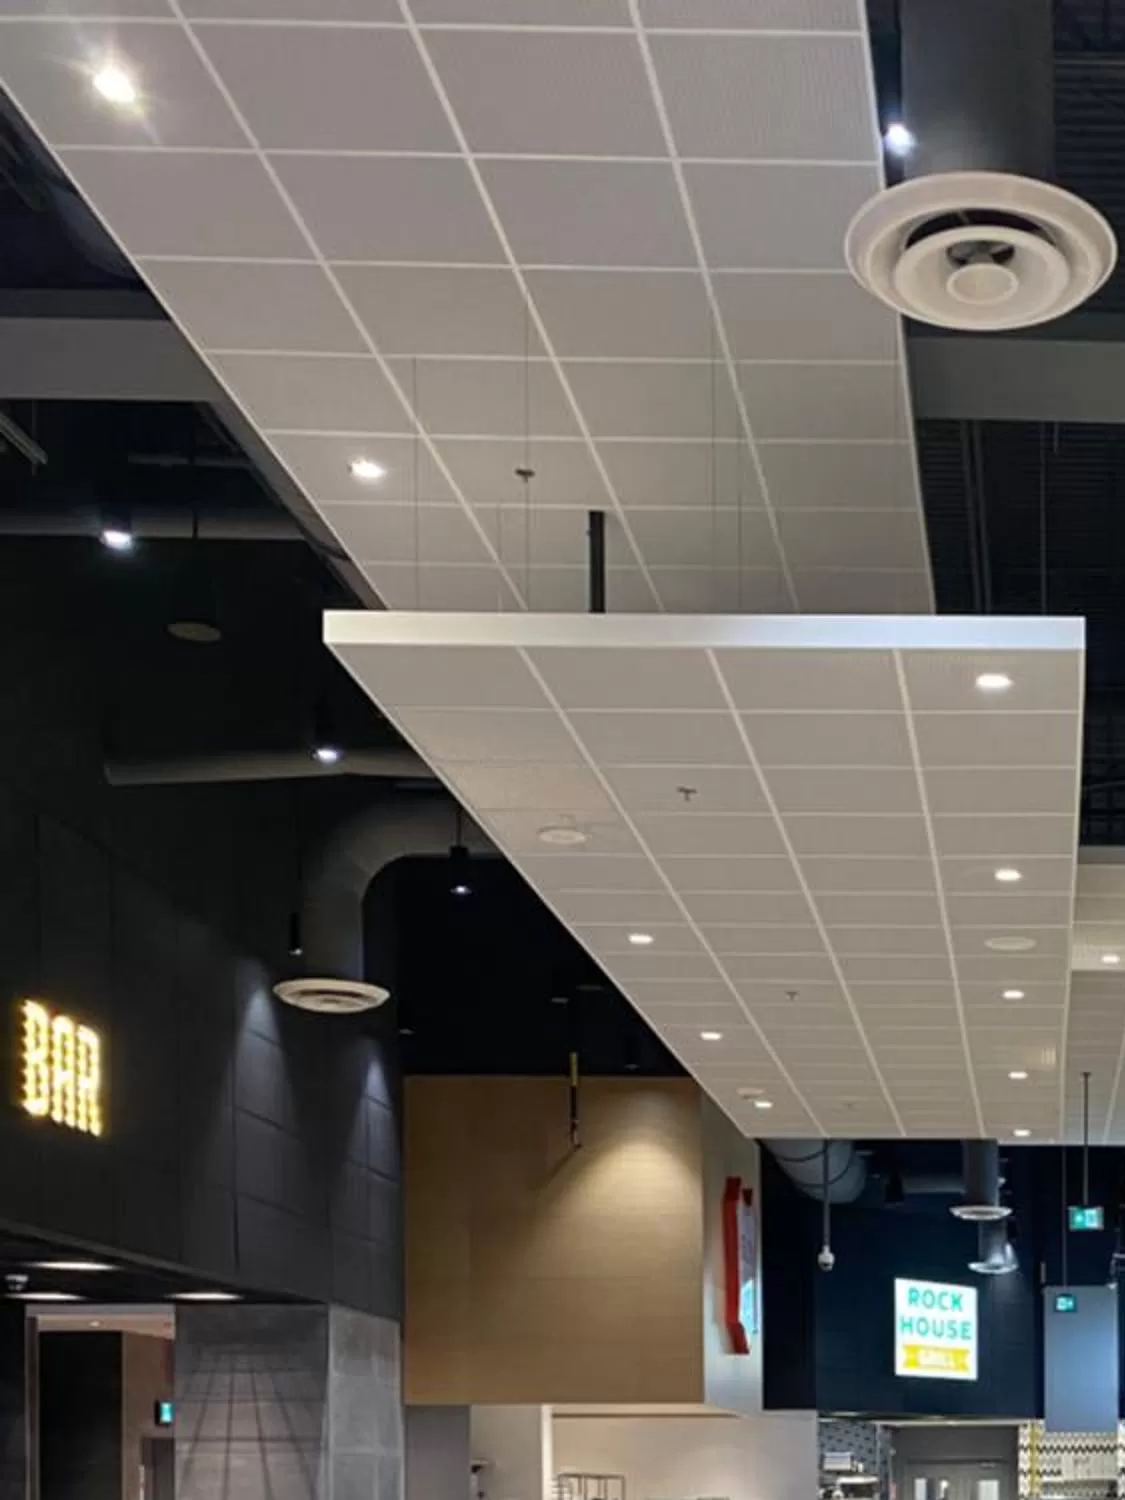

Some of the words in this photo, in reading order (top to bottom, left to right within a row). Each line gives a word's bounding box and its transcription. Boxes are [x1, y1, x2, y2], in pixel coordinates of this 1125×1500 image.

[21, 1000, 103, 1137] BAR
[907, 1287, 963, 1312] ROCK
[900, 1316, 972, 1341] HOUSE
